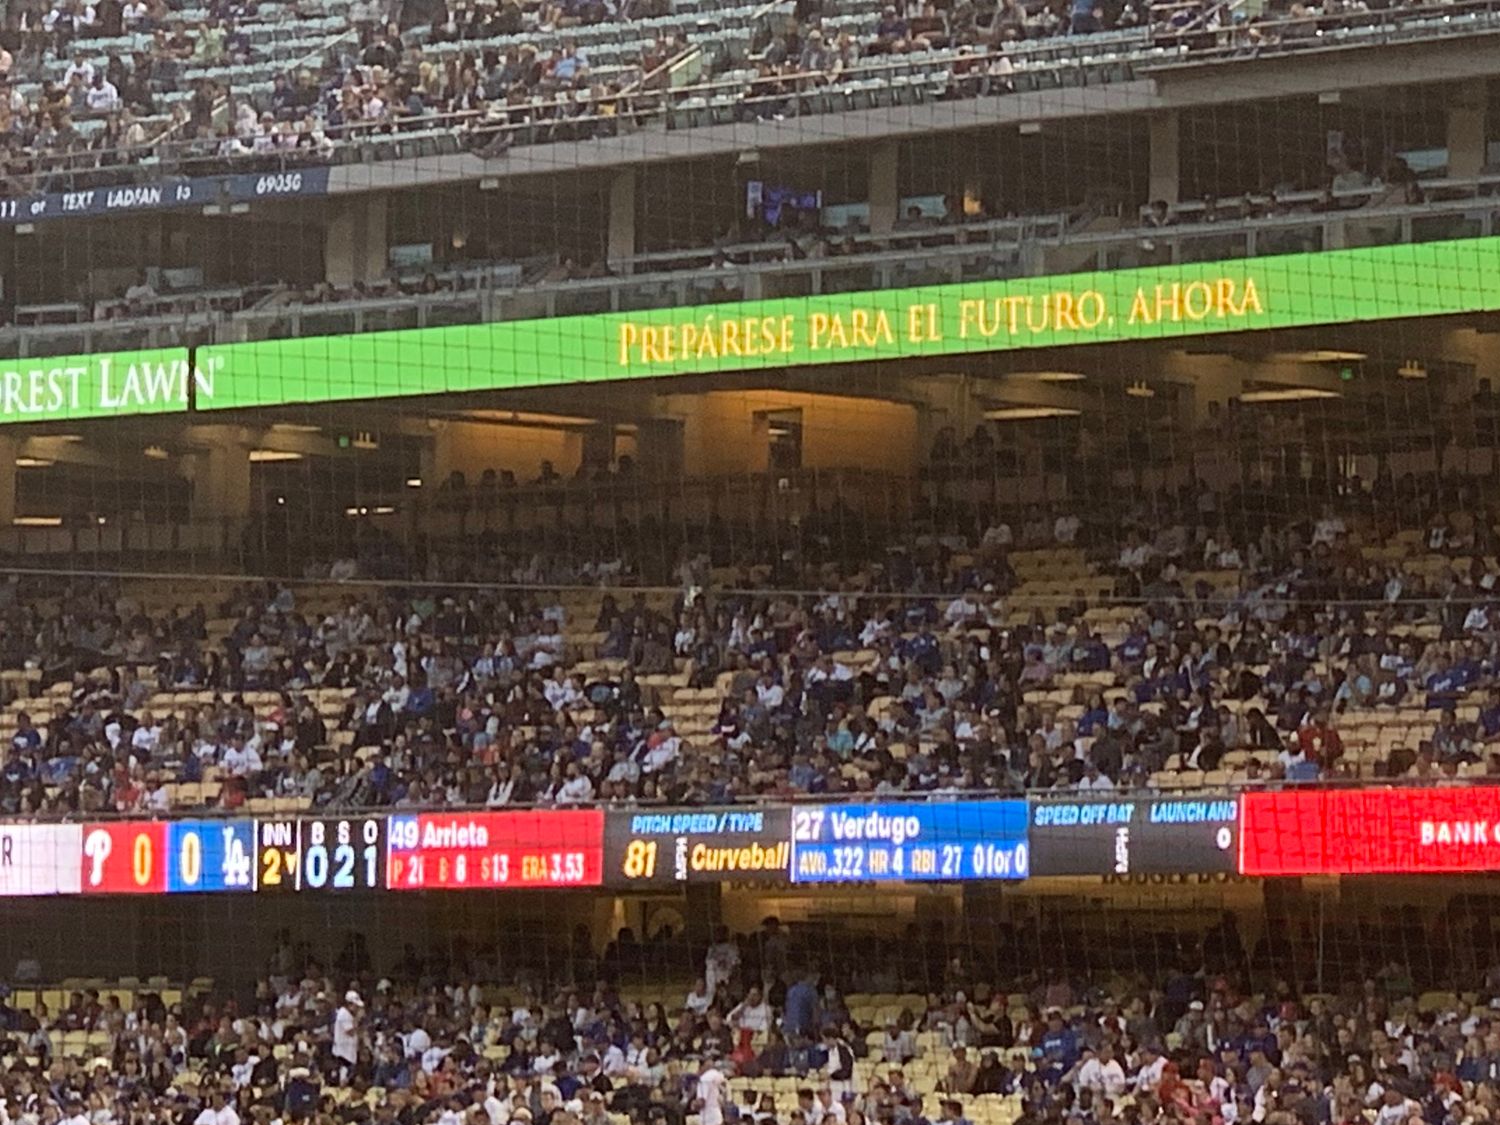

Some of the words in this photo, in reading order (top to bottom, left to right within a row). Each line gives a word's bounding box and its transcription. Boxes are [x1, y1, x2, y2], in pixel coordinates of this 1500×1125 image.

[63, 190, 95, 211] TEXT
[618, 312, 795, 367] PREPÁRESE
[808, 306, 895, 350] PARA
[908, 302, 943, 342] EL
[1127, 276, 1263, 326] AHORA
[0, 367, 88, 415] REST
[631, 813, 671, 834] PITCH
[673, 813, 718, 833] SPEED
[730, 812, 764, 832] TYPE
[796, 812, 825, 841] 27
[831, 810, 921, 846] Verdugo
[1034, 804, 1079, 826] SPEED
[1080, 804, 1108, 825] OFF
[1106, 803, 1135, 824] BAT
[1150, 802, 1207, 824] LAUNCH
[262, 823, 292, 847] INN
[310, 821, 326, 845] B
[336, 821, 350, 845] S
[390, 820, 419, 849] 49
[421, 819, 489, 849] Arrieta
[1420, 820, 1488, 846] BANK
[133, 833, 153, 887] 0
[180, 831, 201, 886] 0
[262, 848, 282, 886] 2
[305, 844, 329, 889] 0
[333, 844, 355, 889] 2
[363, 845, 377, 889] 1
[492, 853, 510, 883] 13
[521, 855, 548, 881] ERA
[550, 852, 585, 883] 3.53
[624, 839, 658, 878] 81
[691, 841, 791, 871] Curveball
[869, 848, 889, 874] HR
[892, 846, 904, 876] 4
[911, 848, 936, 874] RBI
[942, 845, 963, 875] 27
[973, 842, 985, 875] 0
[986, 842, 1013, 875] for
[1014, 842, 1027, 874] 0
